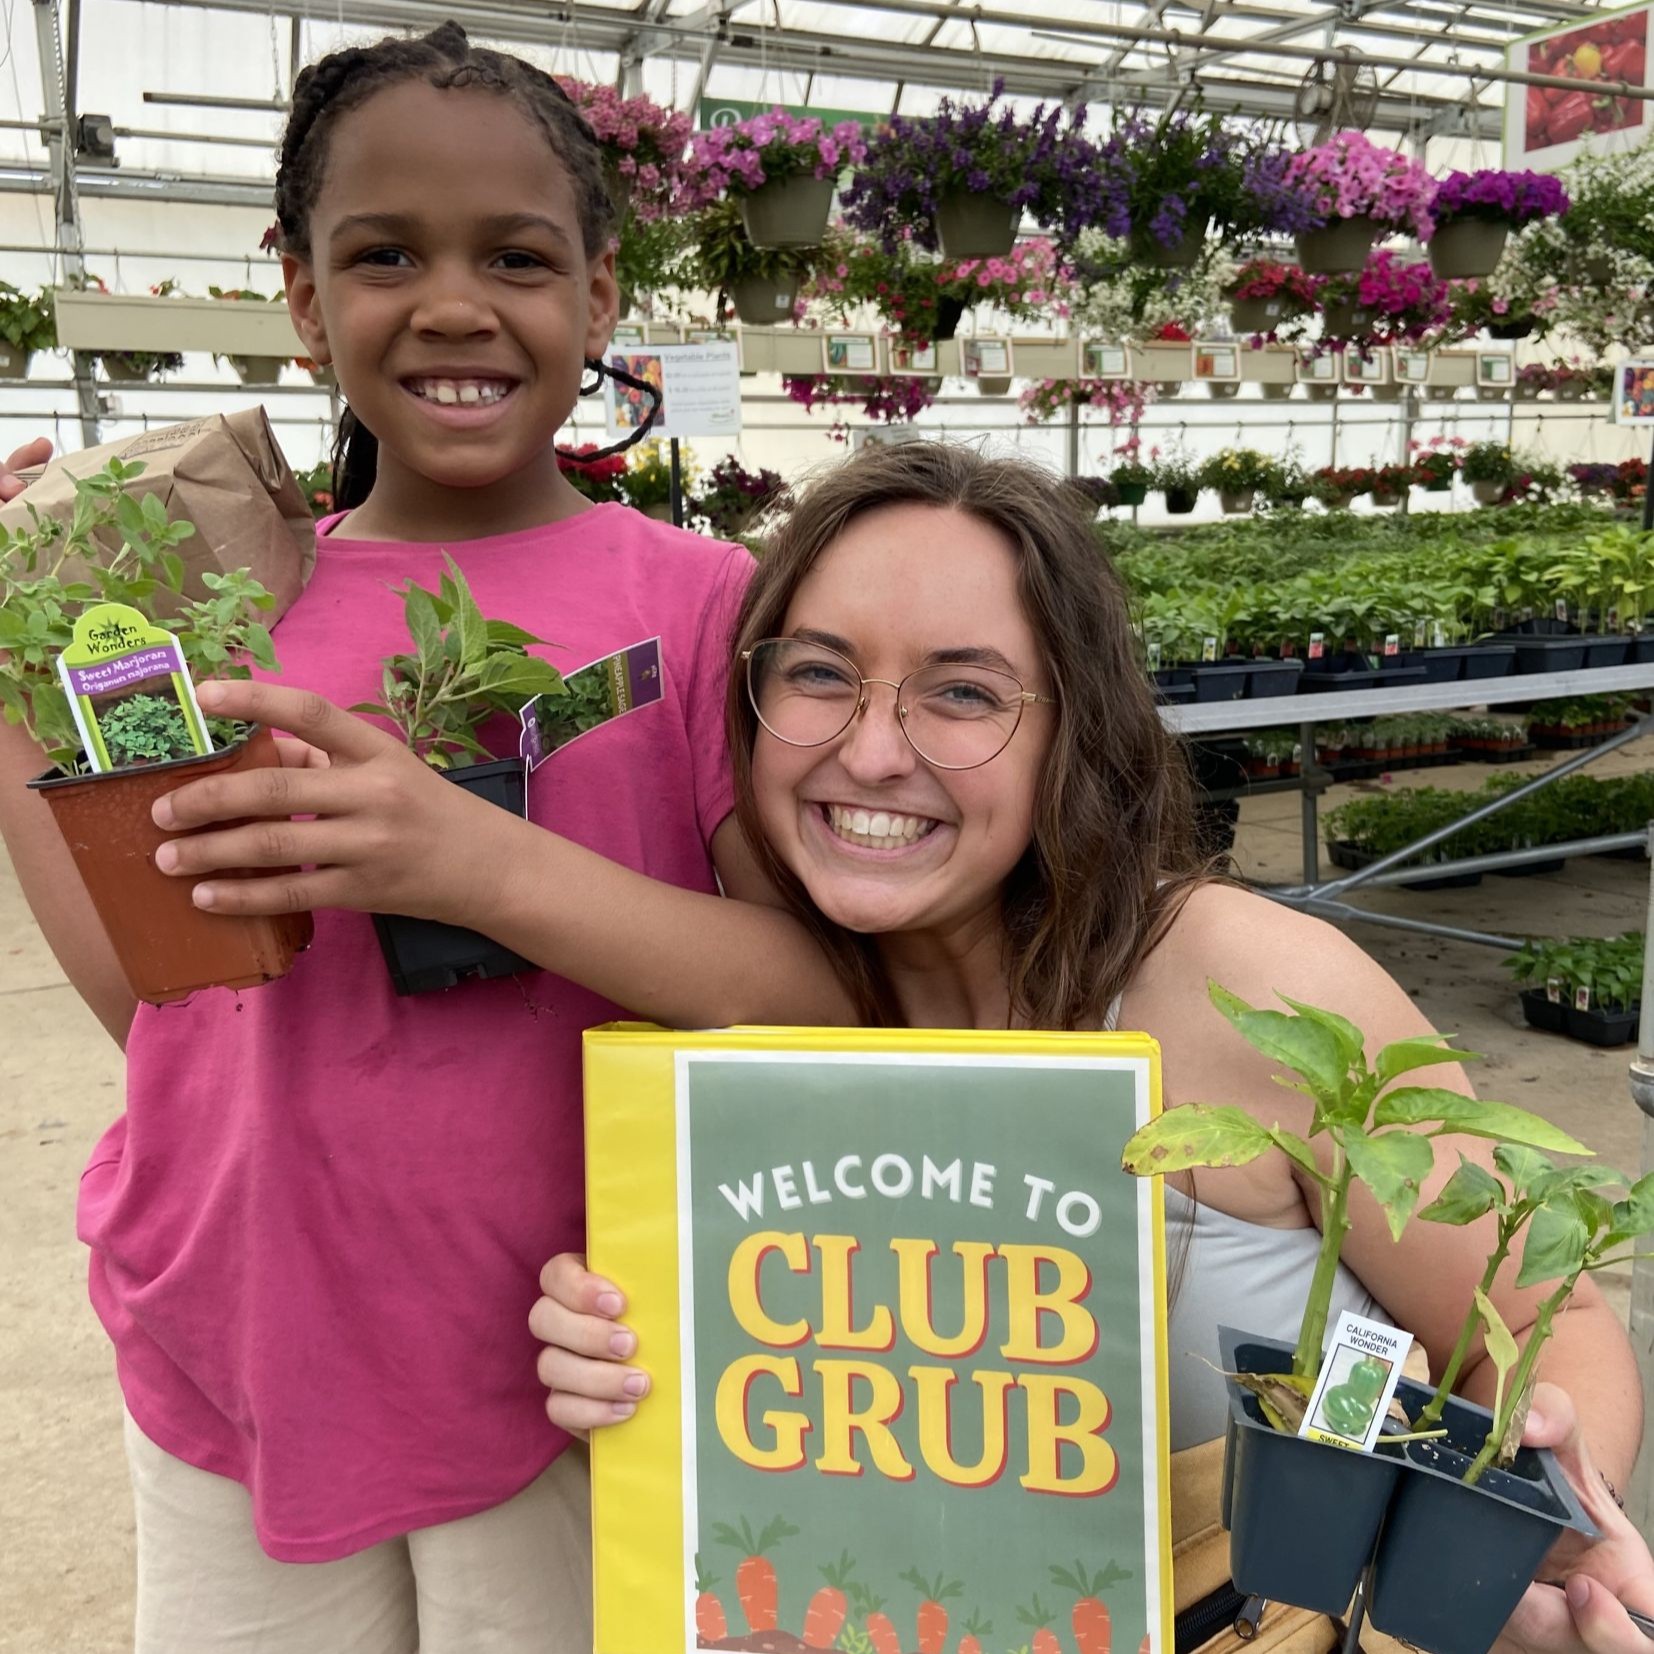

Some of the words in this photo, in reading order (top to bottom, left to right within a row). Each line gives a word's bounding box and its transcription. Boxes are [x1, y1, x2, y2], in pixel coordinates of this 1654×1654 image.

[664, 352, 704, 362] Vegetable
[706, 352, 731, 361] Plants
[86, 635, 147, 655] Wonders
[88, 624, 138, 641] Garden
[78, 666, 112, 682] Sweet
[113, 651, 168, 674] Marjoram
[82, 675, 127, 692] Origanum
[127, 662, 171, 680] majorana
[613, 654, 625, 694] PINEAPPLE
[617, 693, 627, 714] SAGE
[718, 1153, 998, 1223] WELCOME
[1023, 1174, 1102, 1238] TO
[728, 1230, 1101, 1367] CLUB
[1346, 1324, 1398, 1349] CALIFORNIA
[1350, 1335, 1389, 1356] WONDER
[715, 1353, 1120, 1498] GRUB
